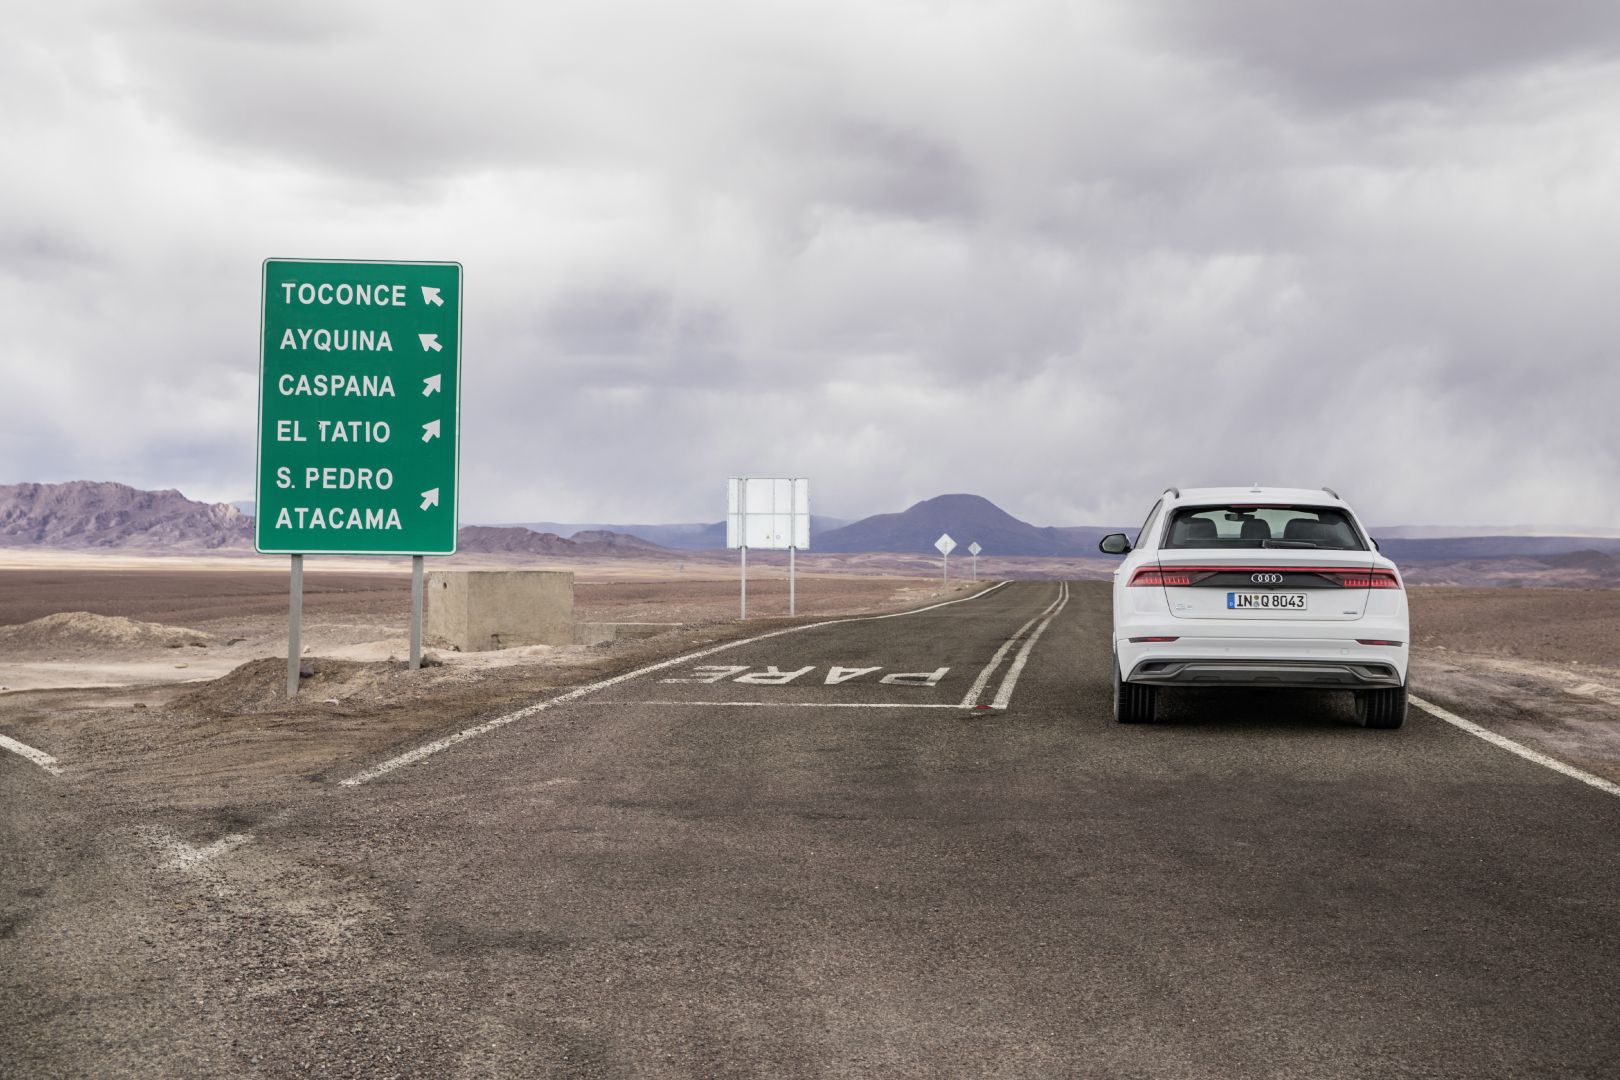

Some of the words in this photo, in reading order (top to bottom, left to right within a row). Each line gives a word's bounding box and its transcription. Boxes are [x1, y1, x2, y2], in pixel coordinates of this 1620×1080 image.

[281, 283, 406, 306] TOCONCE
[280, 329, 393, 351] AYQUINA
[278, 374, 396, 397] CASPANA
[277, 420, 307, 442] EL
[318, 421, 391, 443] TATIO
[276, 467, 296, 489] S.
[305, 468, 393, 490] PEDRO
[275, 508, 402, 530] ATACAMA
[1237, 594, 1252, 607] IN
[1272, 595, 1305, 608] 8043
[657, 665, 950, 687] PARE
